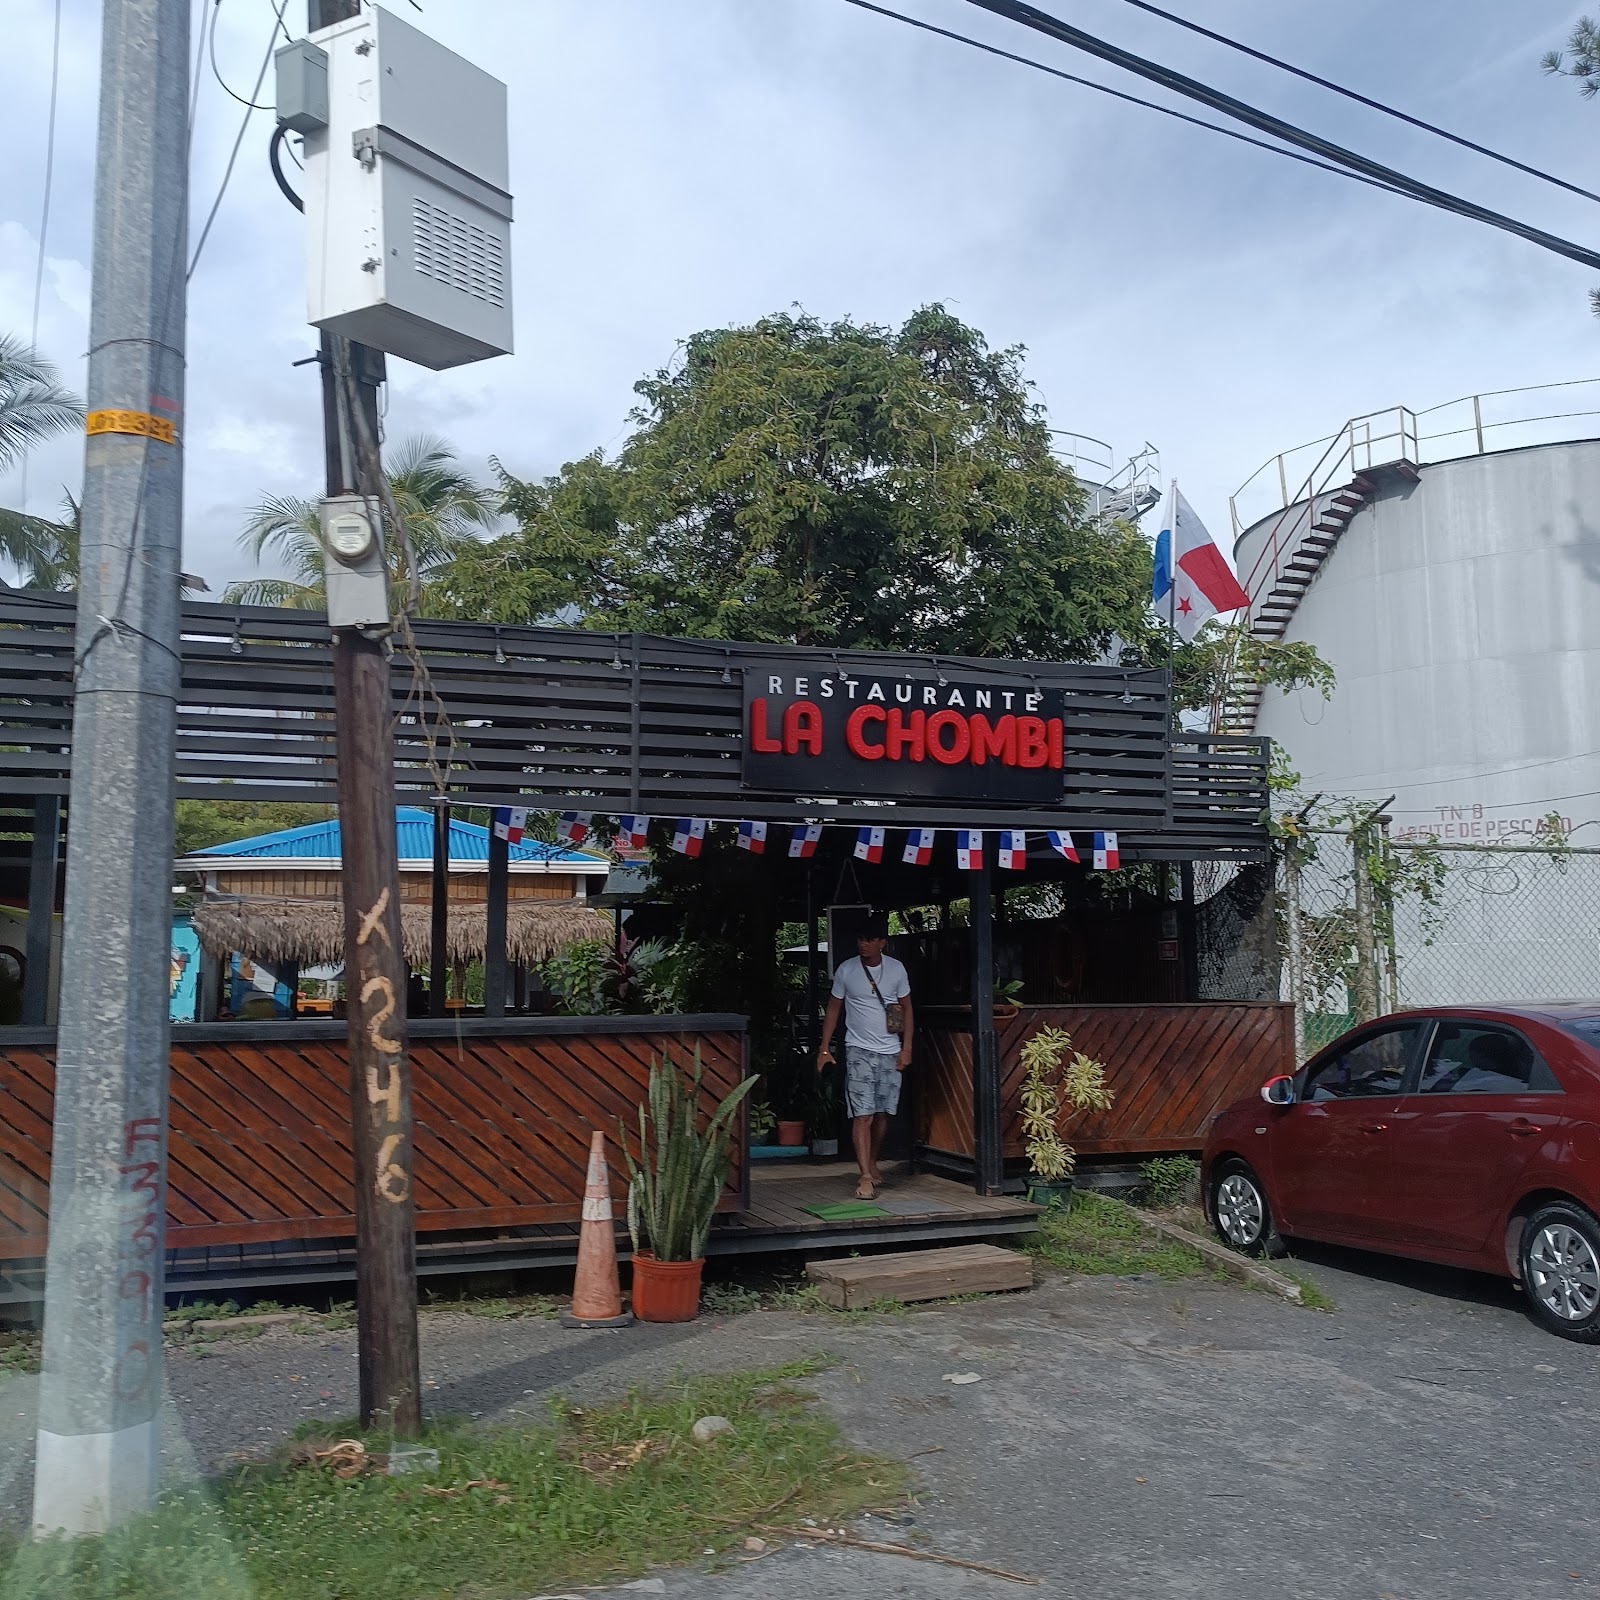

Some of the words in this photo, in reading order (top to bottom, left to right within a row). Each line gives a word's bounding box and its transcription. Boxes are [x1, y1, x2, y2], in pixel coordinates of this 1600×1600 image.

[768, 675, 1039, 711] RESTAURANTE
[751, 697, 823, 756] LA
[846, 703, 1064, 769] CHOMBI
[1459, 822, 1481, 838] DE
[1486, 817, 1572, 836] PESCAO
